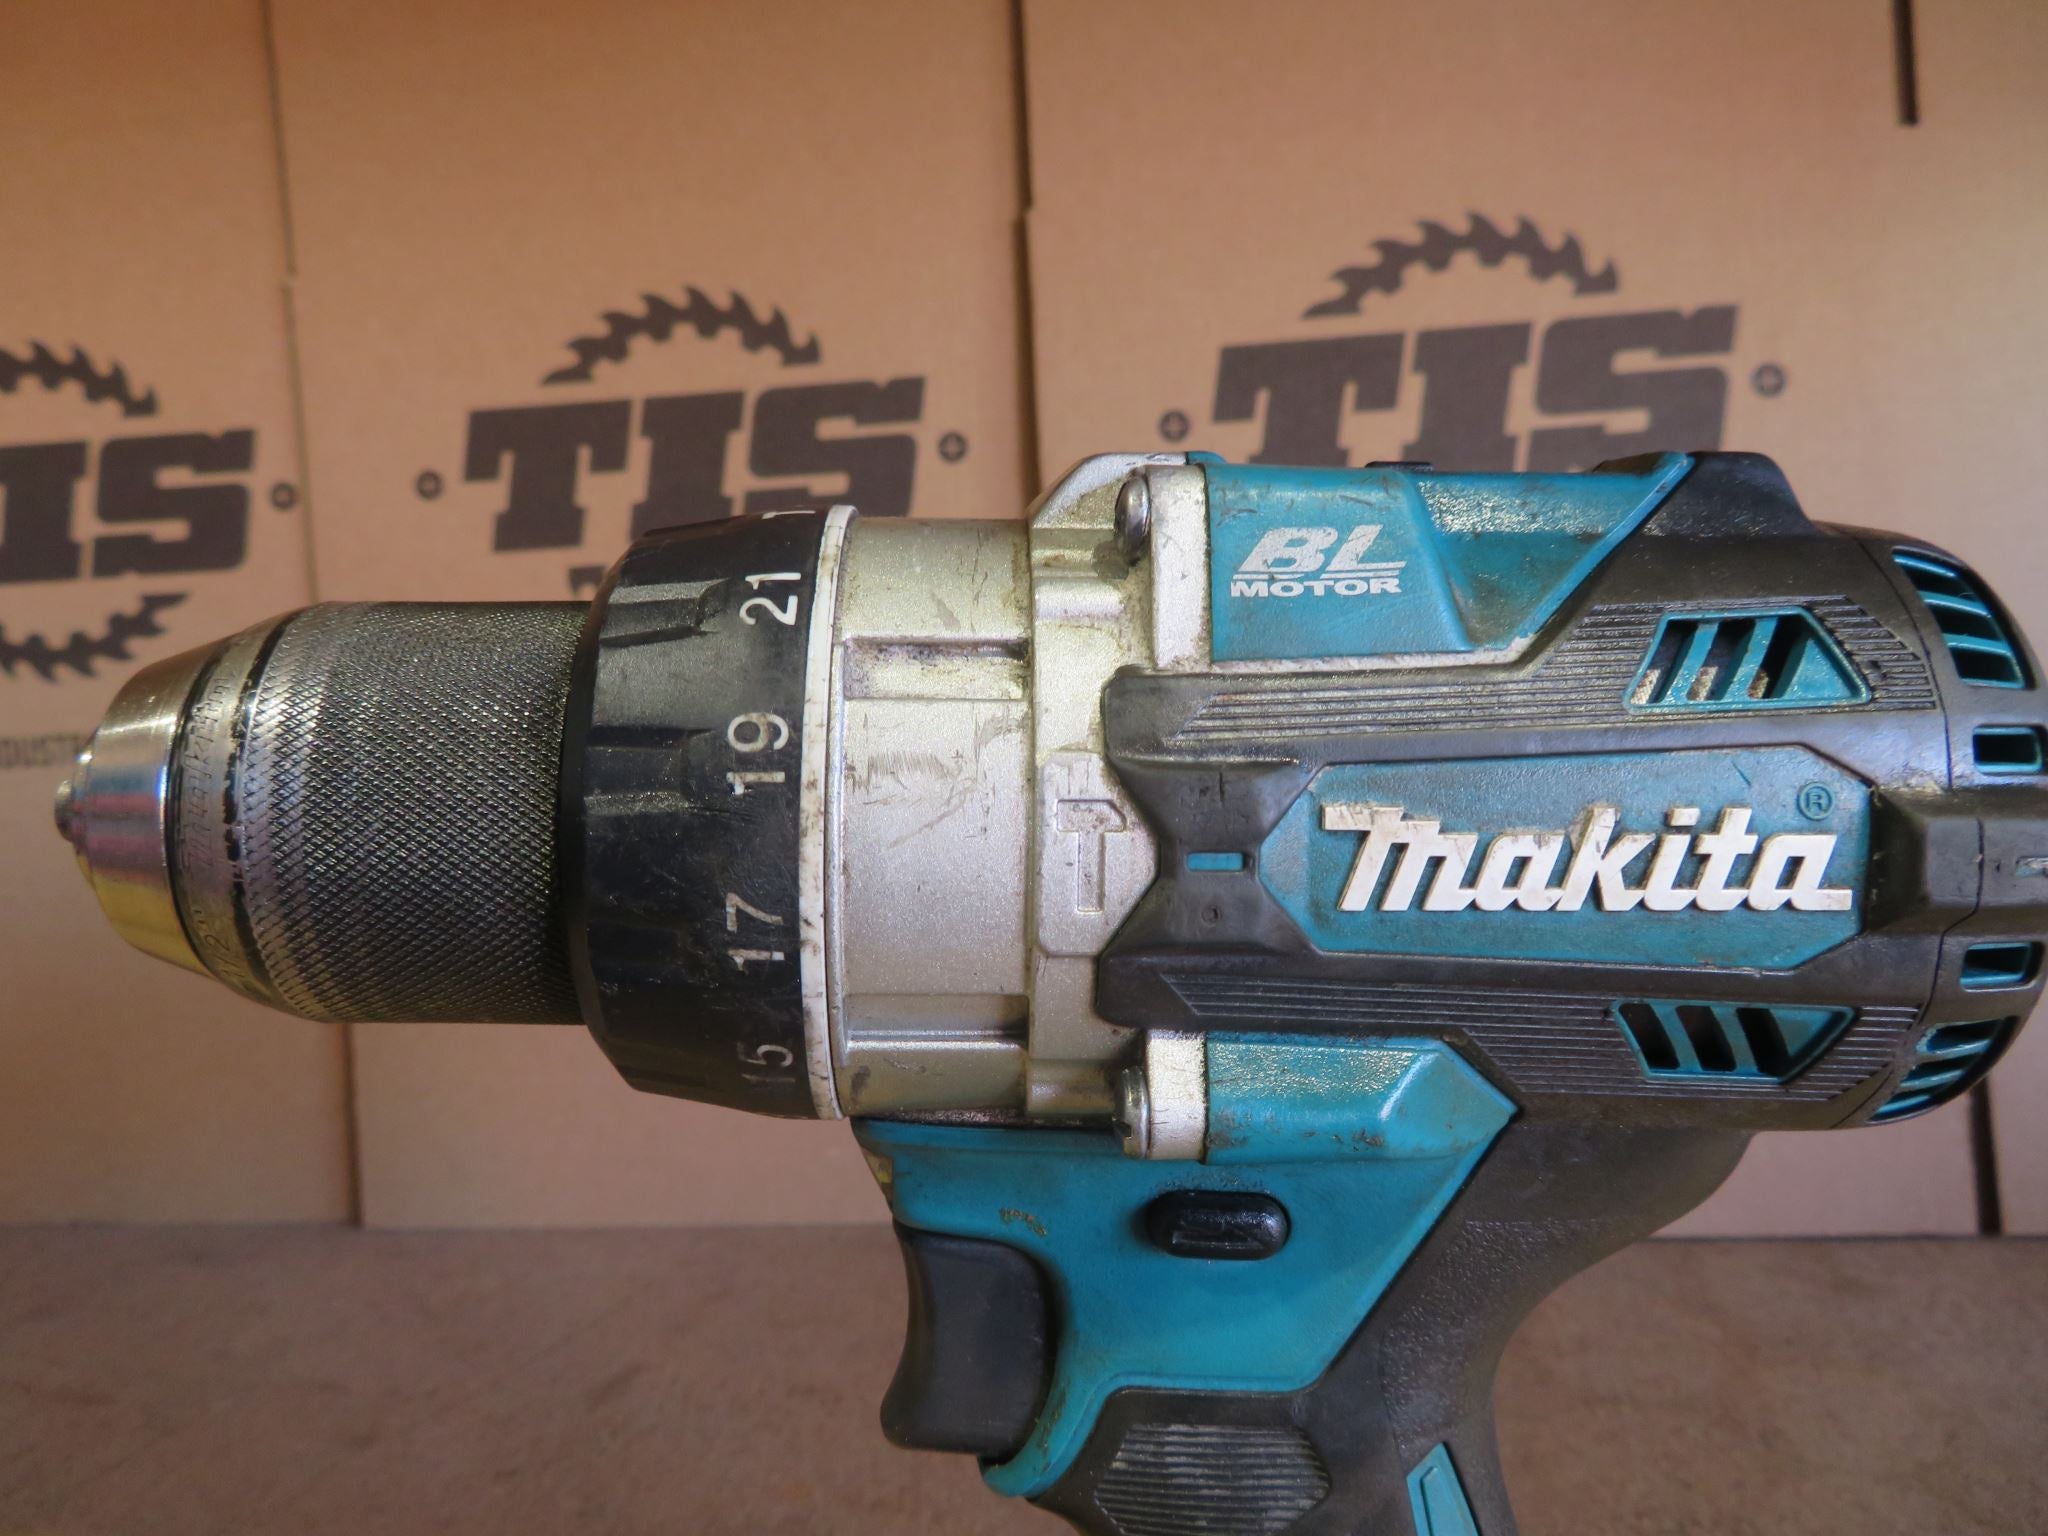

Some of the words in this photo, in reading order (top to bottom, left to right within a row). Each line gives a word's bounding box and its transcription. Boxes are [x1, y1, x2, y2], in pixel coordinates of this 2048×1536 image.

[1212, 304, 1741, 473] TIS
[464, 376, 926, 552] TIS
[1231, 578, 1403, 598] MOTOR
[1237, 524, 1407, 574] BL
[739, 571, 802, 626] 21
[726, 711, 789, 796] 19
[725, 891, 785, 972] 17
